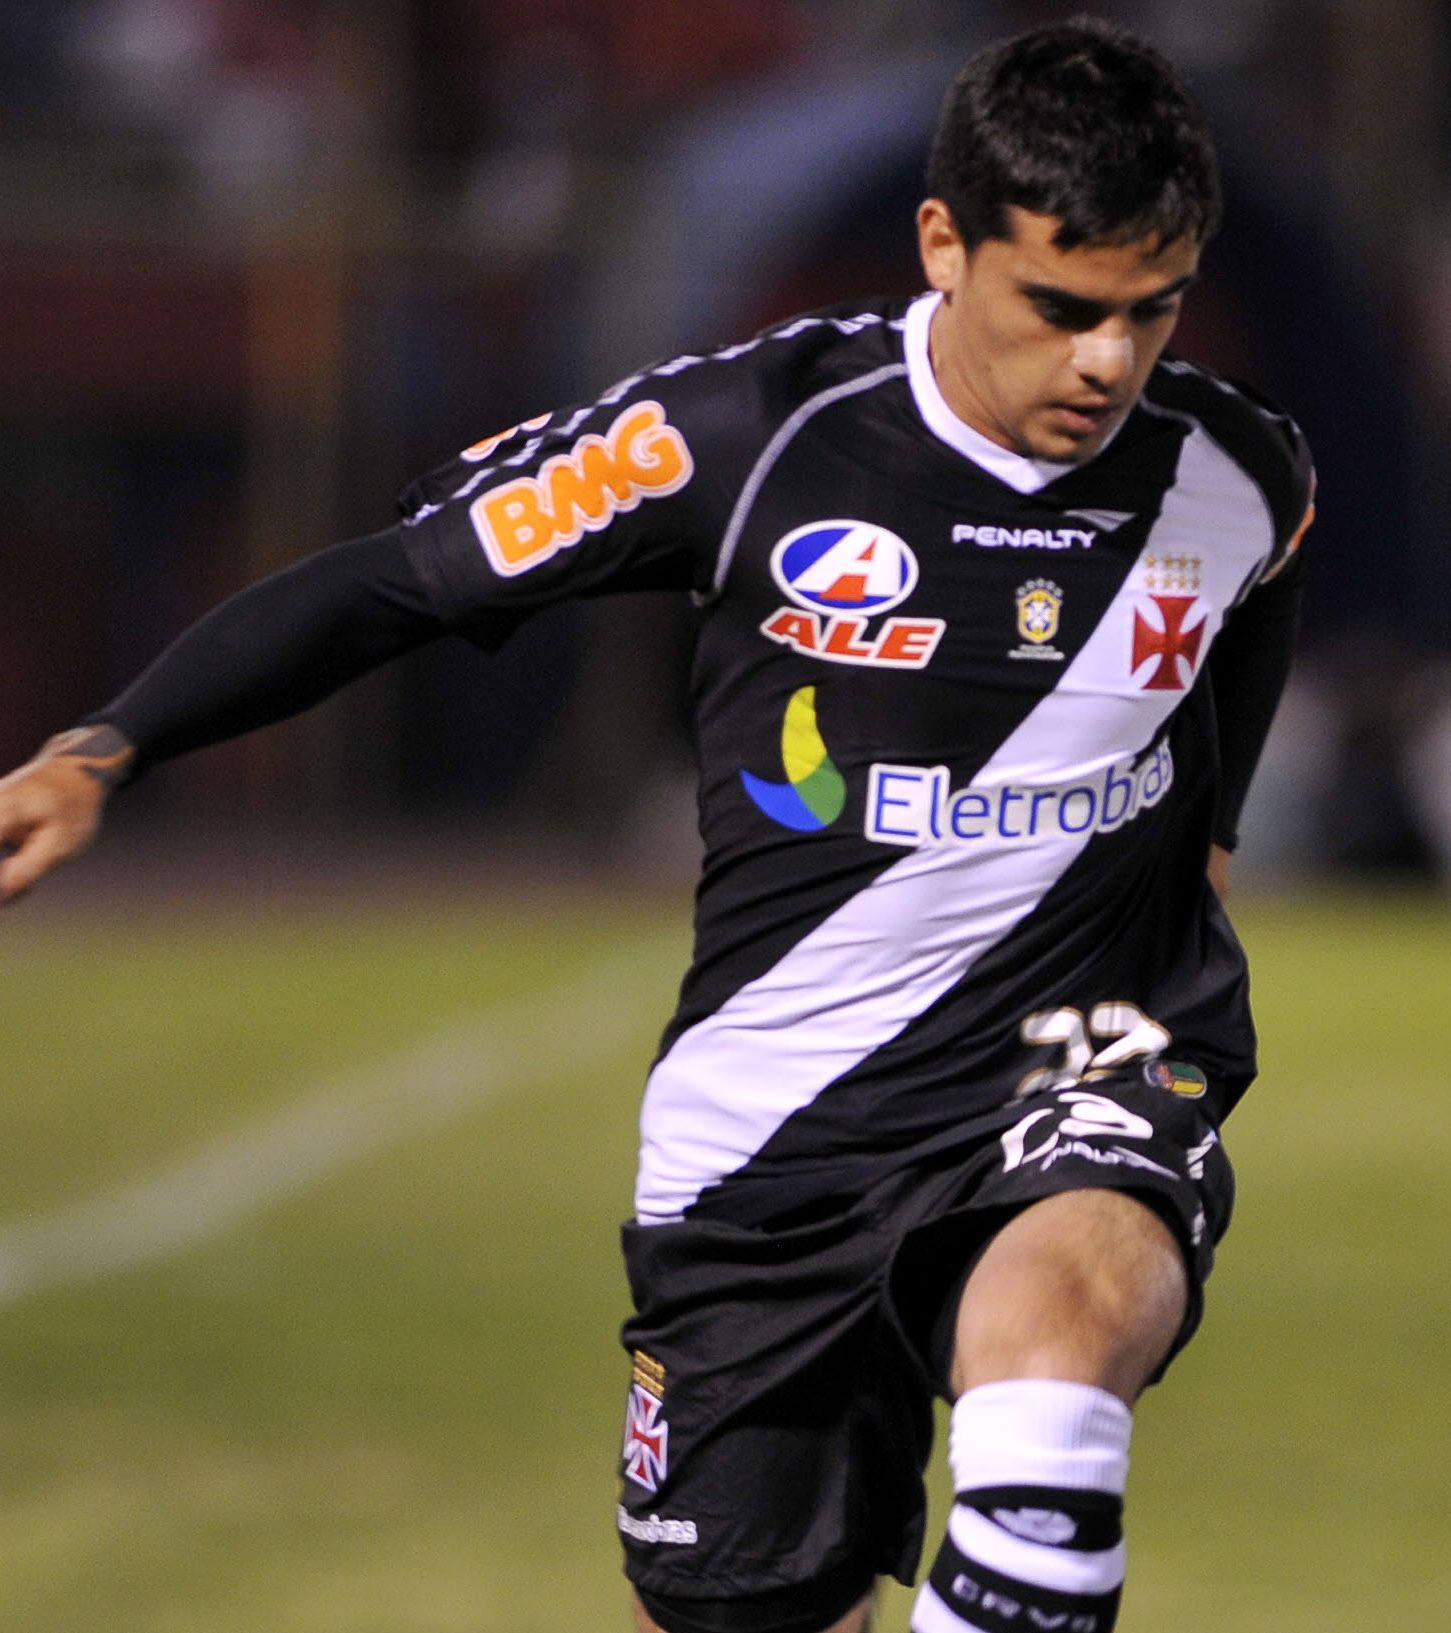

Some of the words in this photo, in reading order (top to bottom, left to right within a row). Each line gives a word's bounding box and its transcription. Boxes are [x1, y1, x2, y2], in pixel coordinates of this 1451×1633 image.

[478, 404, 690, 571] BMG
[953, 524, 1097, 549] PENALTY
[764, 610, 940, 664] ALE
